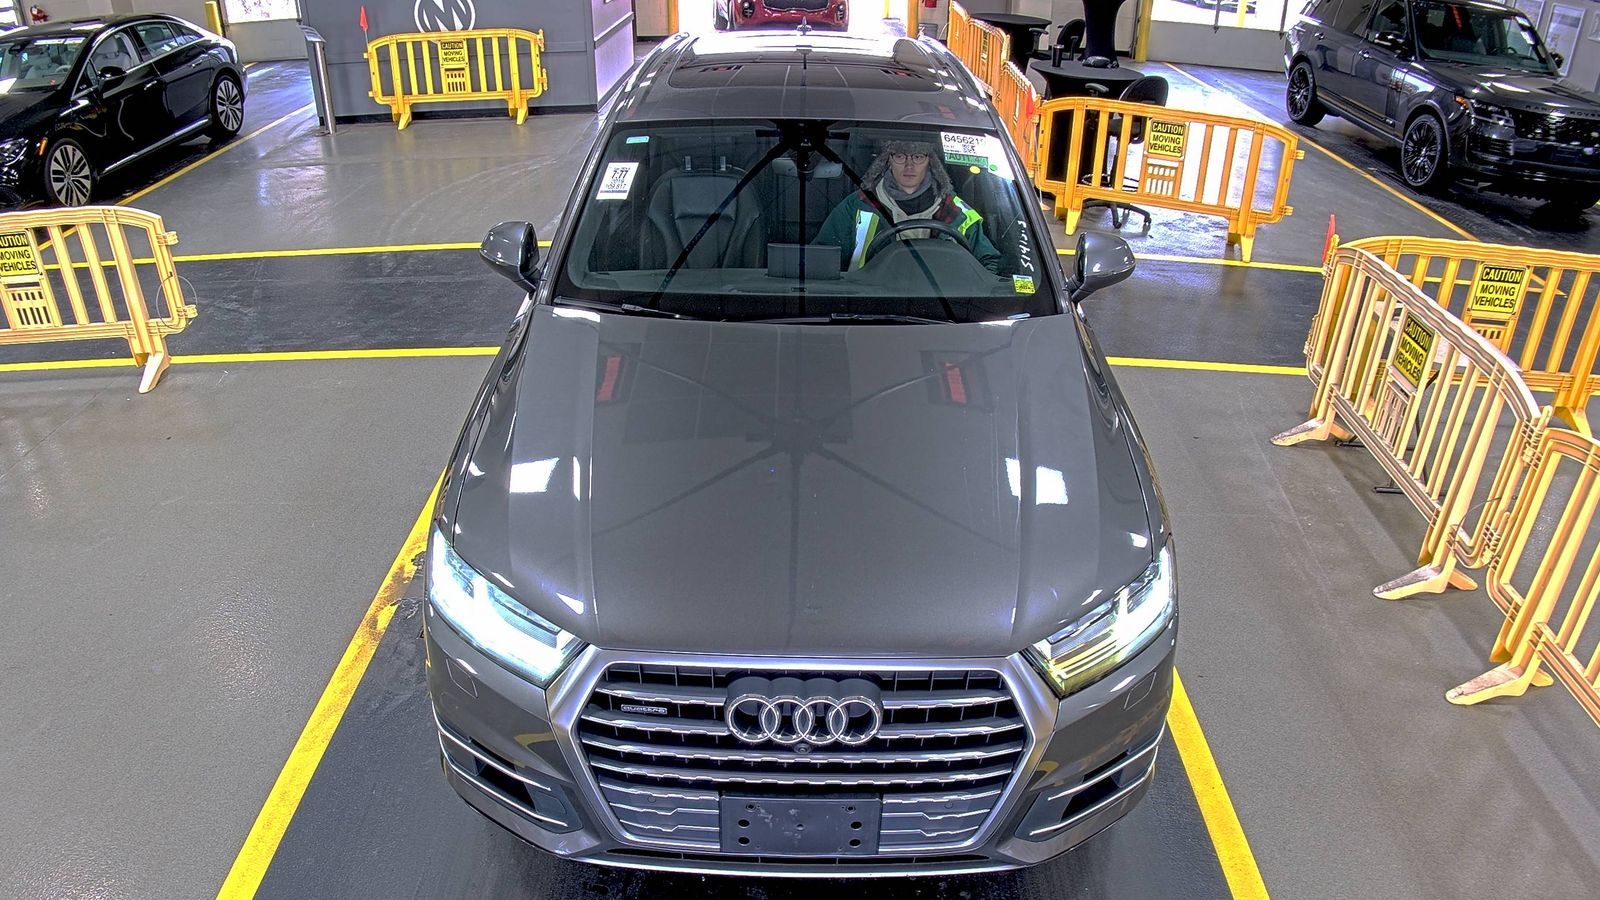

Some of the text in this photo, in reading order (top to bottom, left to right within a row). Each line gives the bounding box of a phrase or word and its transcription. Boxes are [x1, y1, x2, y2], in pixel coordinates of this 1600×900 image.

[1152, 122, 1184, 135] CAUTION
[1152, 134, 1181, 145] MOVING
[1149, 142, 1182, 154] VEHICLES
[0, 235, 28, 247] AUTION
[0, 260, 37, 272] VEHICLES
[1482, 268, 1523, 283] CAUTION
[1480, 284, 1516, 297] MOVING
[1475, 296, 1515, 309] VEHICLES
[1405, 317, 1432, 351] CAUTION
[1400, 336, 1424, 366] MOVING
[1396, 351, 1421, 382] VEHICLES
